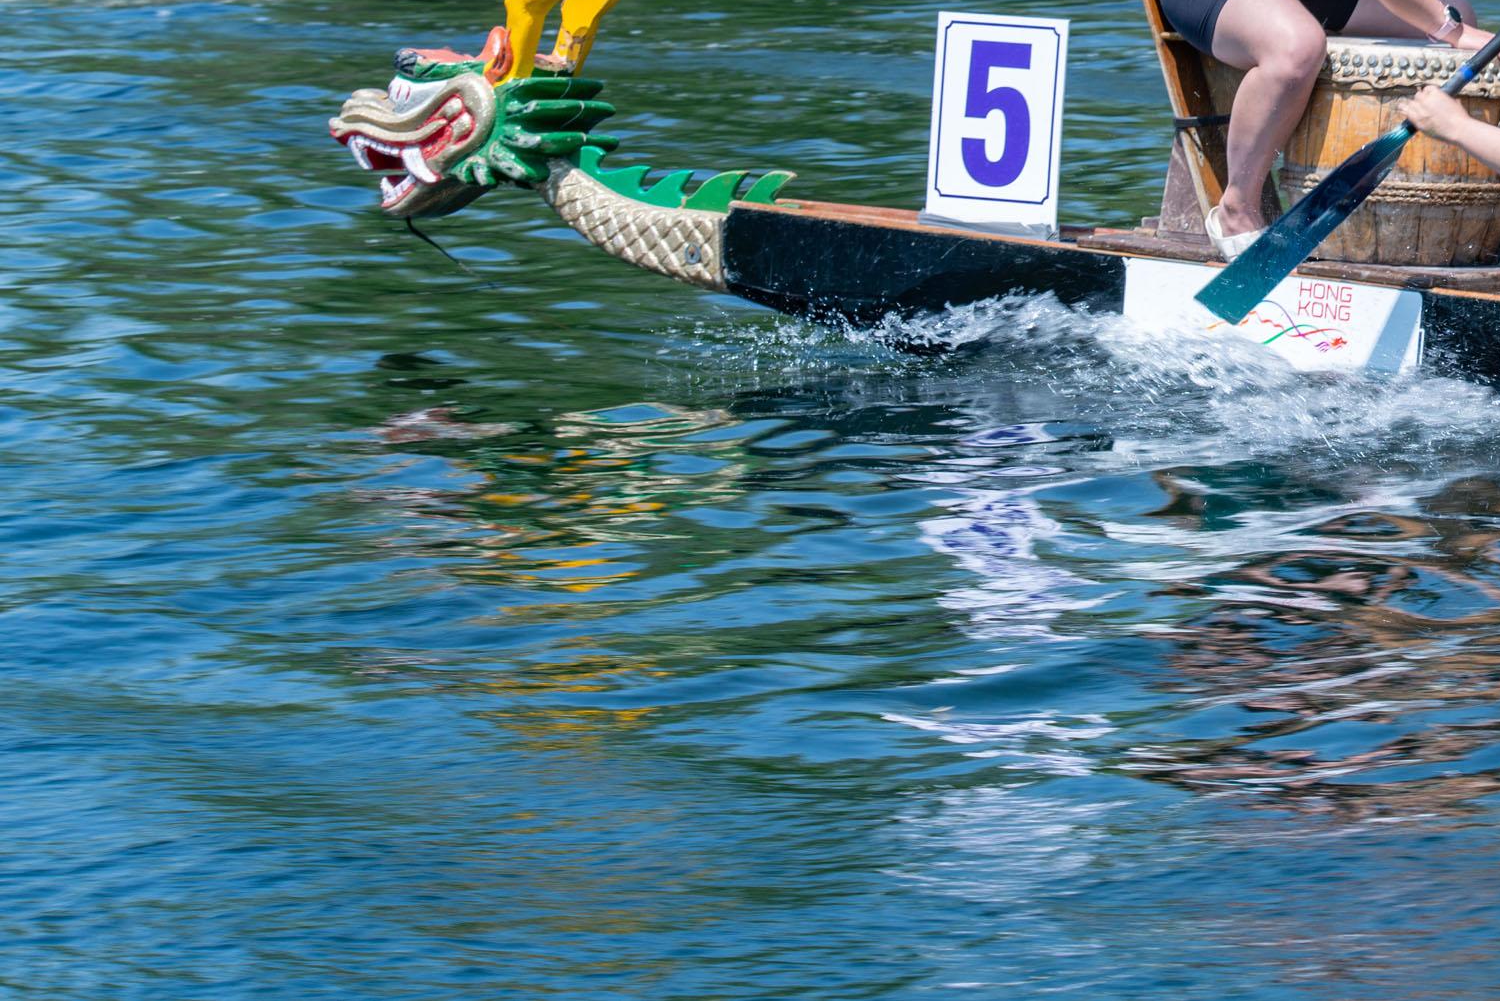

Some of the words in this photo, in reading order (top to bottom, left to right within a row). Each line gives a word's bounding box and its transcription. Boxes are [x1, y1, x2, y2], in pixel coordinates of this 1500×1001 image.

[961, 40, 1032, 188] 5
[1299, 281, 1352, 303] HONG
[1297, 300, 1351, 322] KONG
